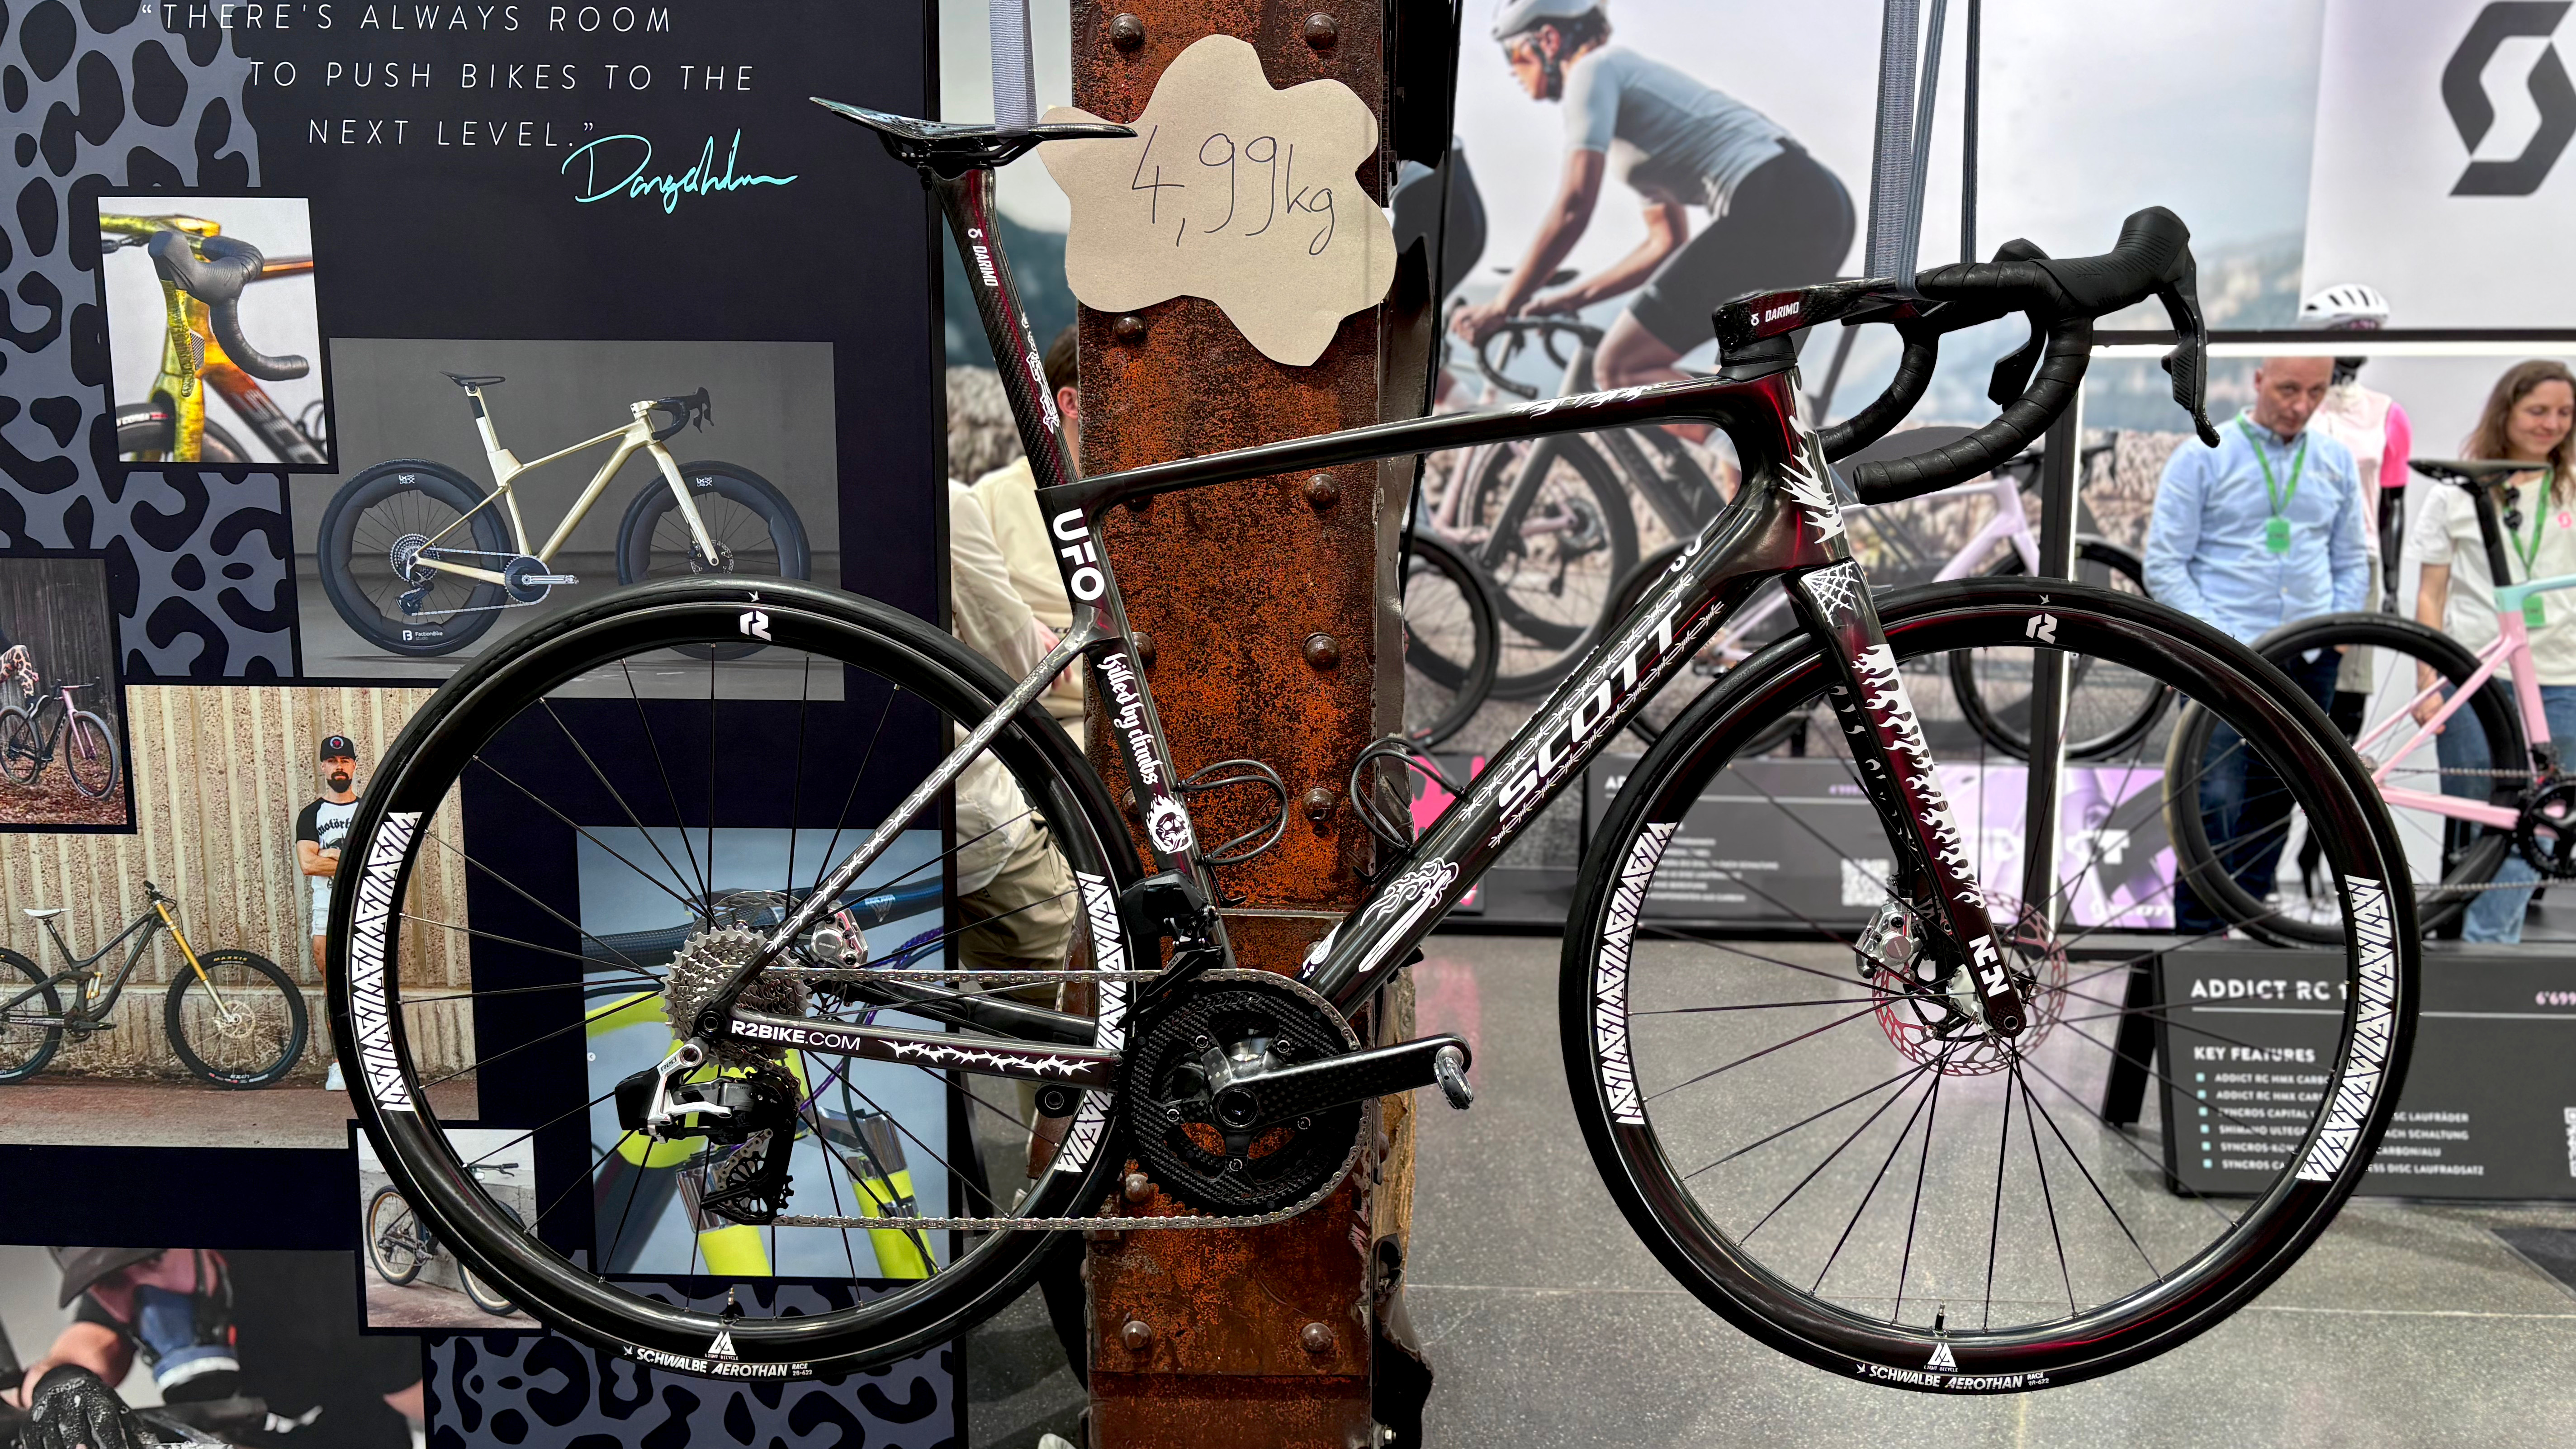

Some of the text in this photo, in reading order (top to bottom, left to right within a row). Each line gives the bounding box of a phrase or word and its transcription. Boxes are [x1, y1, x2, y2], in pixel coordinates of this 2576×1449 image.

[360, 5, 519, 31] ALWAYS
[549, 7, 670, 33] ROOM
[251, 62, 753, 90] TO PUSH BIKES TO THE
[310, 119, 409, 145] NEXT
[973, 245, 999, 286] DARIMO
[1765, 302, 1799, 322] DARIMO
[1053, 508, 1105, 601] UFO
[1097, 653, 1159, 786] killed by climbs
[1498, 602, 1682, 823] SCOTT
[2191, 979, 2287, 999] ADDICT
[2297, 980, 2330, 1000] RC
[731, 1020, 861, 1051] R2BIKE.COM
[2194, 1046, 2316, 1062] KEY FEATURES
[2215, 1073, 2252, 1083] ADDICT
[2255, 1074, 2268, 1083] RC
[2216, 1090, 2253, 1100] ADDICT
[2256, 1091, 2270, 1101] RC
[2267, 1108, 2308, 1119] CAPITAL
[2222, 1159, 2269, 1170] SYNCROS
[636, 1348, 787, 1377] SCHWALBE AEROTHAN
[1869, 1365, 2023, 1390] SCHWALBE AEROTHAN
[2027, 1372, 2044, 1380] RACE
